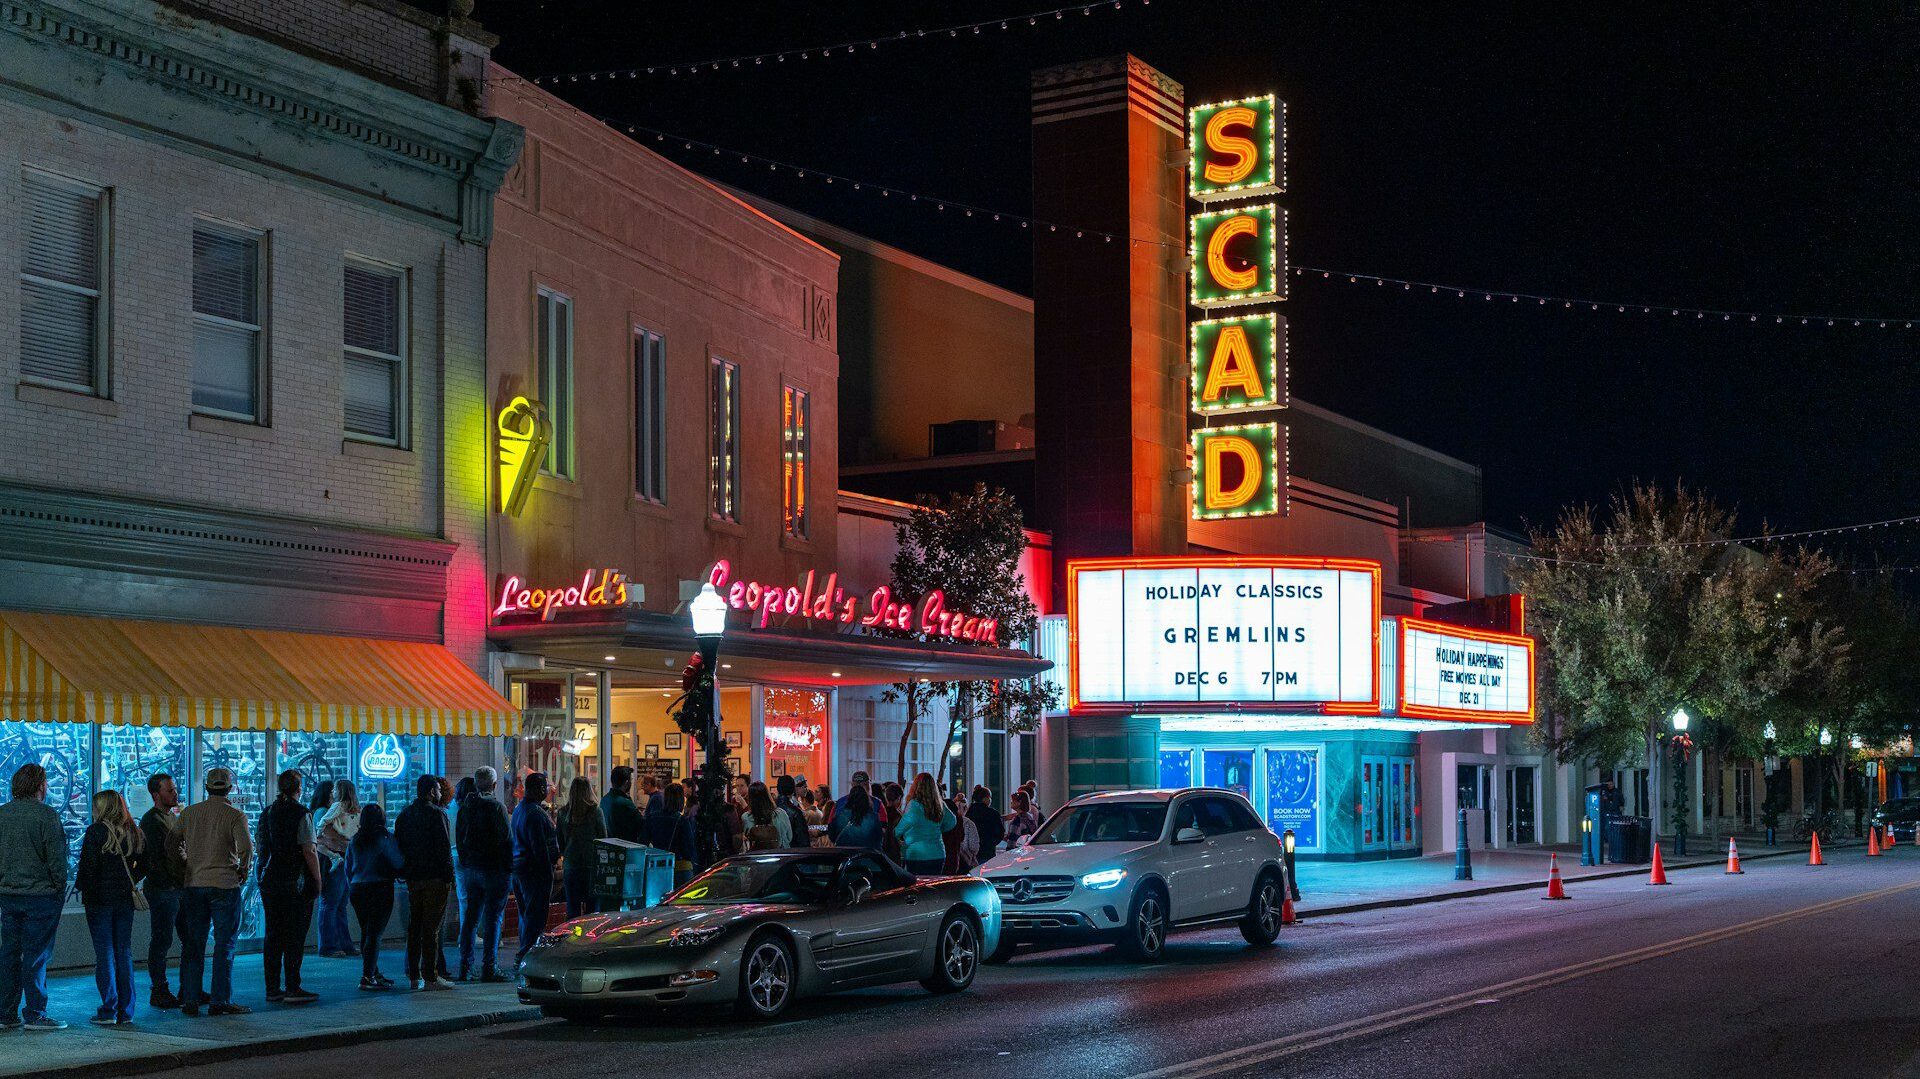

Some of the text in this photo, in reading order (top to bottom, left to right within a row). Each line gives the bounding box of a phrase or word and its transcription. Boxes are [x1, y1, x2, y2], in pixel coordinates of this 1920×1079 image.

[1202, 106, 1266, 511] SCAD
[492, 568, 627, 621] Leopold's
[1146, 584, 1323, 600] HOLIDAY CLASSICS
[861, 585, 912, 630] Ice
[921, 590, 999, 646] Cream
[1164, 626, 1306, 643] GREMLINS
[1436, 647, 1504, 669] HOLIDAY HAPPENINGS
[1175, 671, 1210, 686] DEC
[1217, 671, 1229, 685] 6
[1440, 669, 1501, 687] FREE MOVIES ALL DAY
[1459, 691, 1479, 705] DEC 21
[370, 756, 398, 767] RACING
